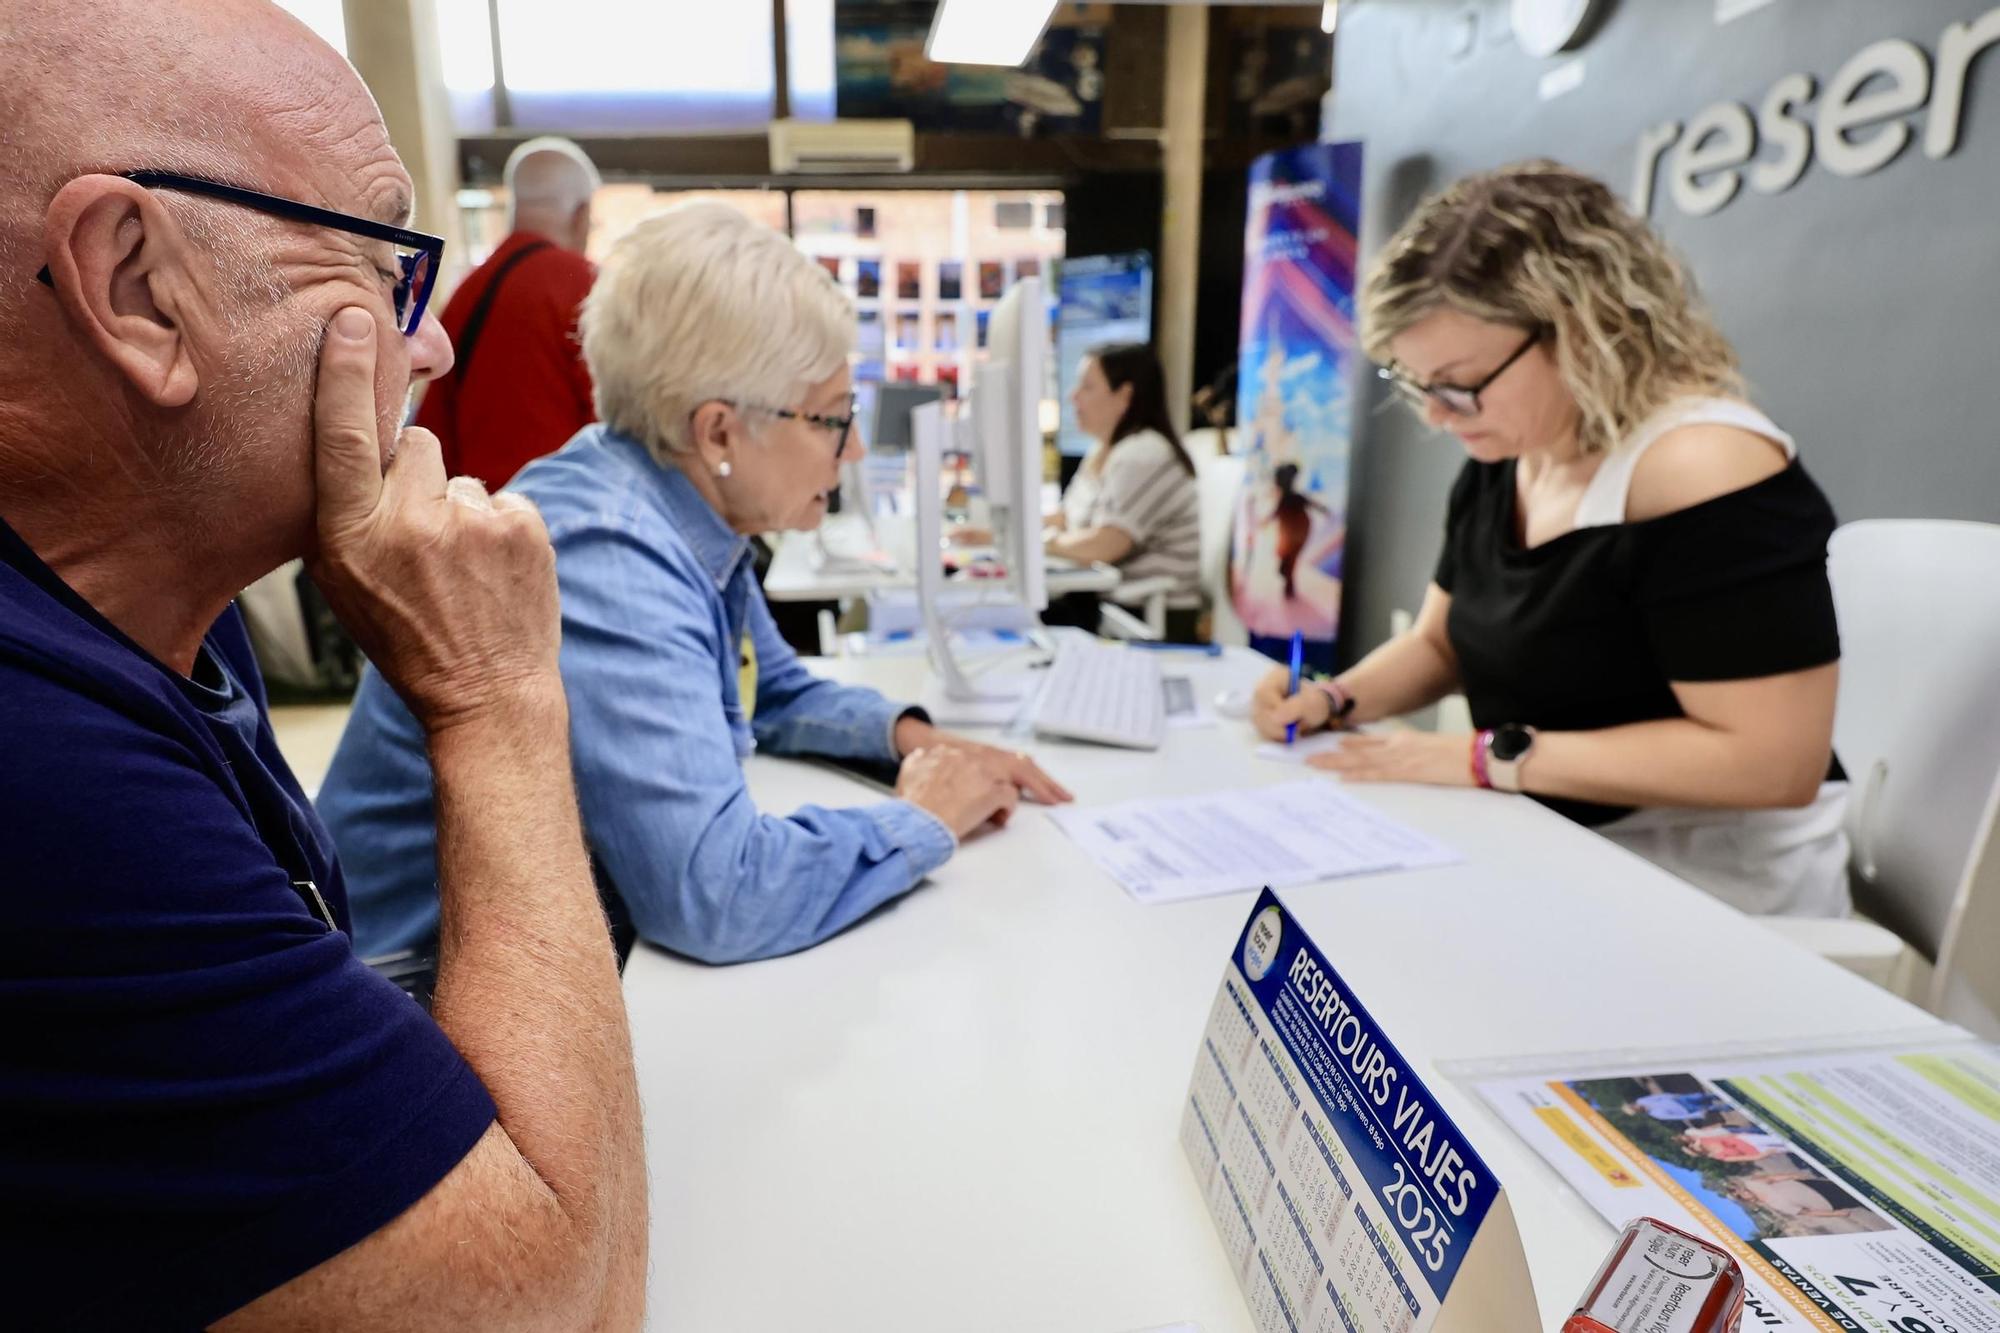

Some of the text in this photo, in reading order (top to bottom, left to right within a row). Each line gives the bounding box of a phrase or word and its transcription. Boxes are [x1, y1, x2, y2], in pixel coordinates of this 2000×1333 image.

[1632, 10, 2000, 220] reser
[1288, 947, 1396, 1105] RESERTOURS
[1393, 1085, 1475, 1215] VIAJES
[1336, 1094, 1347, 1113] Bajo
[1341, 1082, 1353, 1101] Calle
[1372, 1131, 1384, 1151] Bajo
[1317, 1120, 1343, 1165] MARZO
[1293, 1195, 1312, 1234] JULIO
[1382, 1162, 1450, 1270] 2025
[1376, 1221, 1405, 1269] ABRIL
[1648, 1234, 1666, 1254] viajes
[1664, 1241, 1684, 1258] tours
[1678, 1247, 1695, 1266] reser
[1365, 1221, 1372, 1234] M
[1373, 1235, 1380, 1249] M
[1409, 1297, 1416, 1311] D
[1746, 1254, 1783, 1285] COSTA
[1834, 1275, 1879, 1295] 7
[1920, 1248, 1972, 1285] OCTUBRE
[1658, 1282, 1691, 1321] Resertours
[1763, 1259, 1856, 1328] DE VENTAS
[1782, 1287, 1836, 1332] TURISMO
[1879, 1298, 1905, 1312] Y
[1883, 1278, 1958, 1332] OCTUBRE
